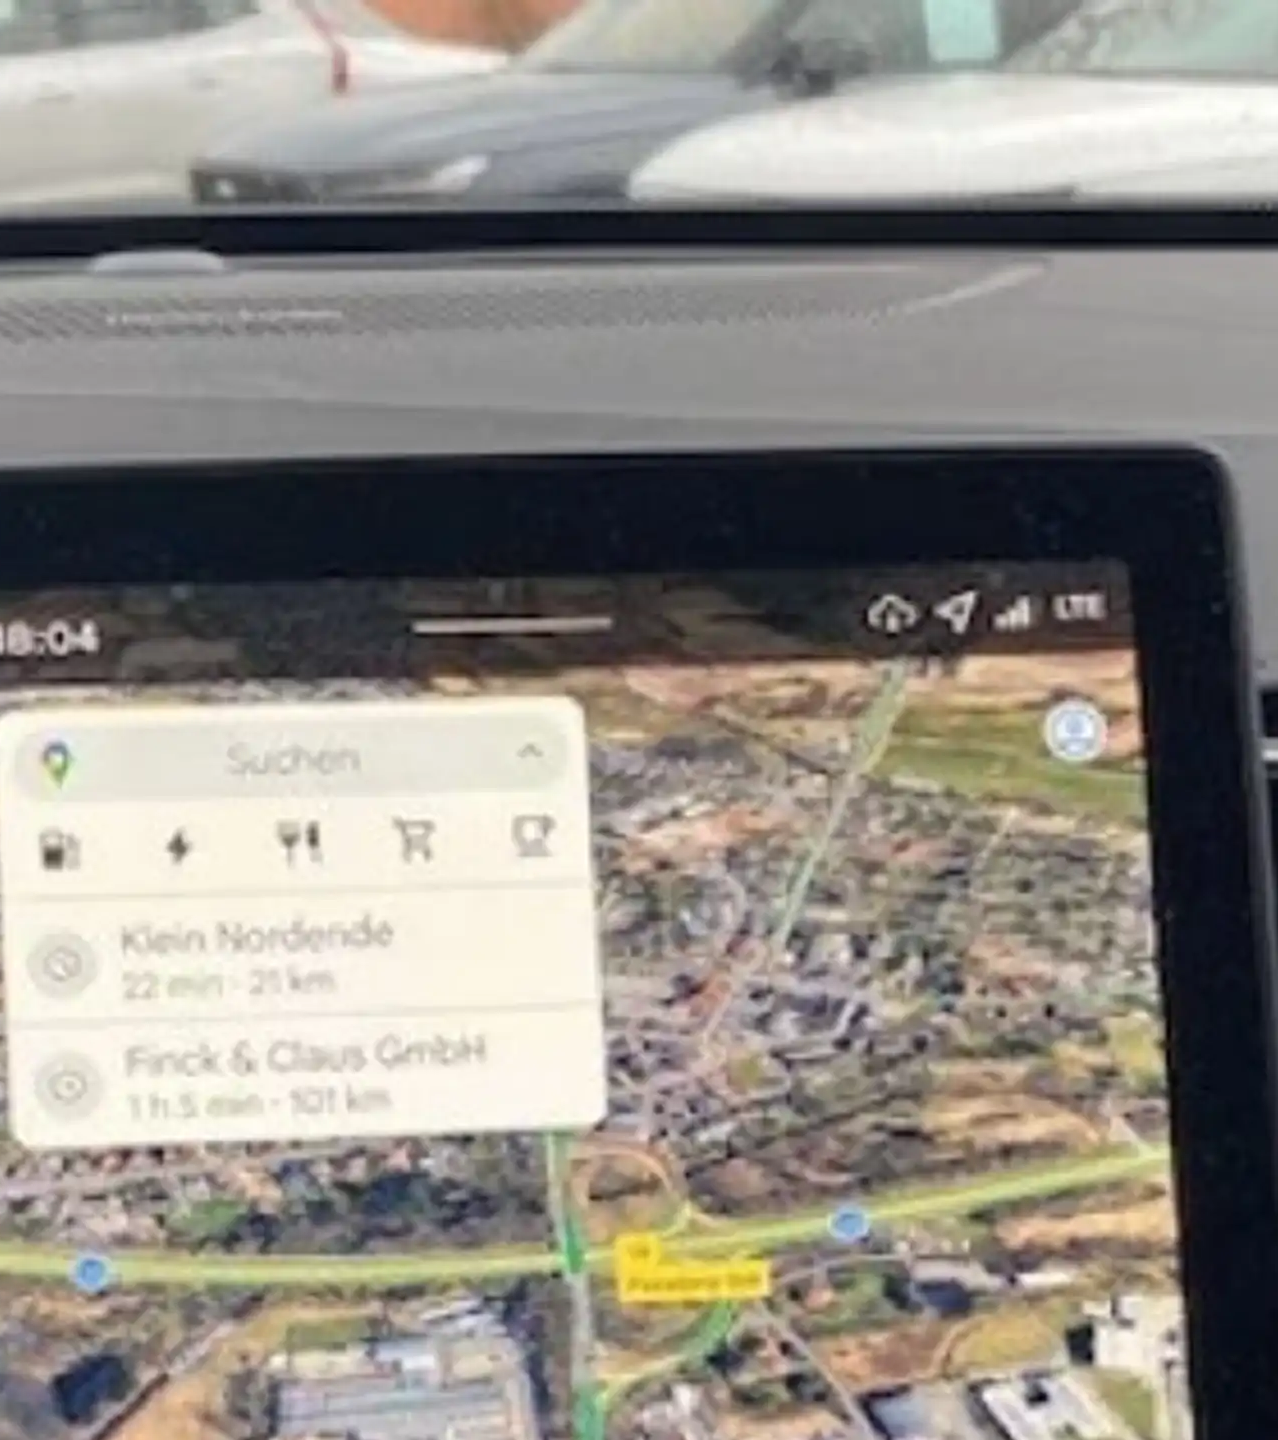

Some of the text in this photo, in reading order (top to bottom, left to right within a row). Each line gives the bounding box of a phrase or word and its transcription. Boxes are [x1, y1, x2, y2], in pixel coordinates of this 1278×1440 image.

[1052, 593, 1107, 621] LTE
[225, 740, 362, 776] Suchen
[121, 913, 394, 956] Klein Nordende
[123, 964, 336, 999] 22 min 21 km
[123, 1033, 486, 1077] Finck & Claus GmbH
